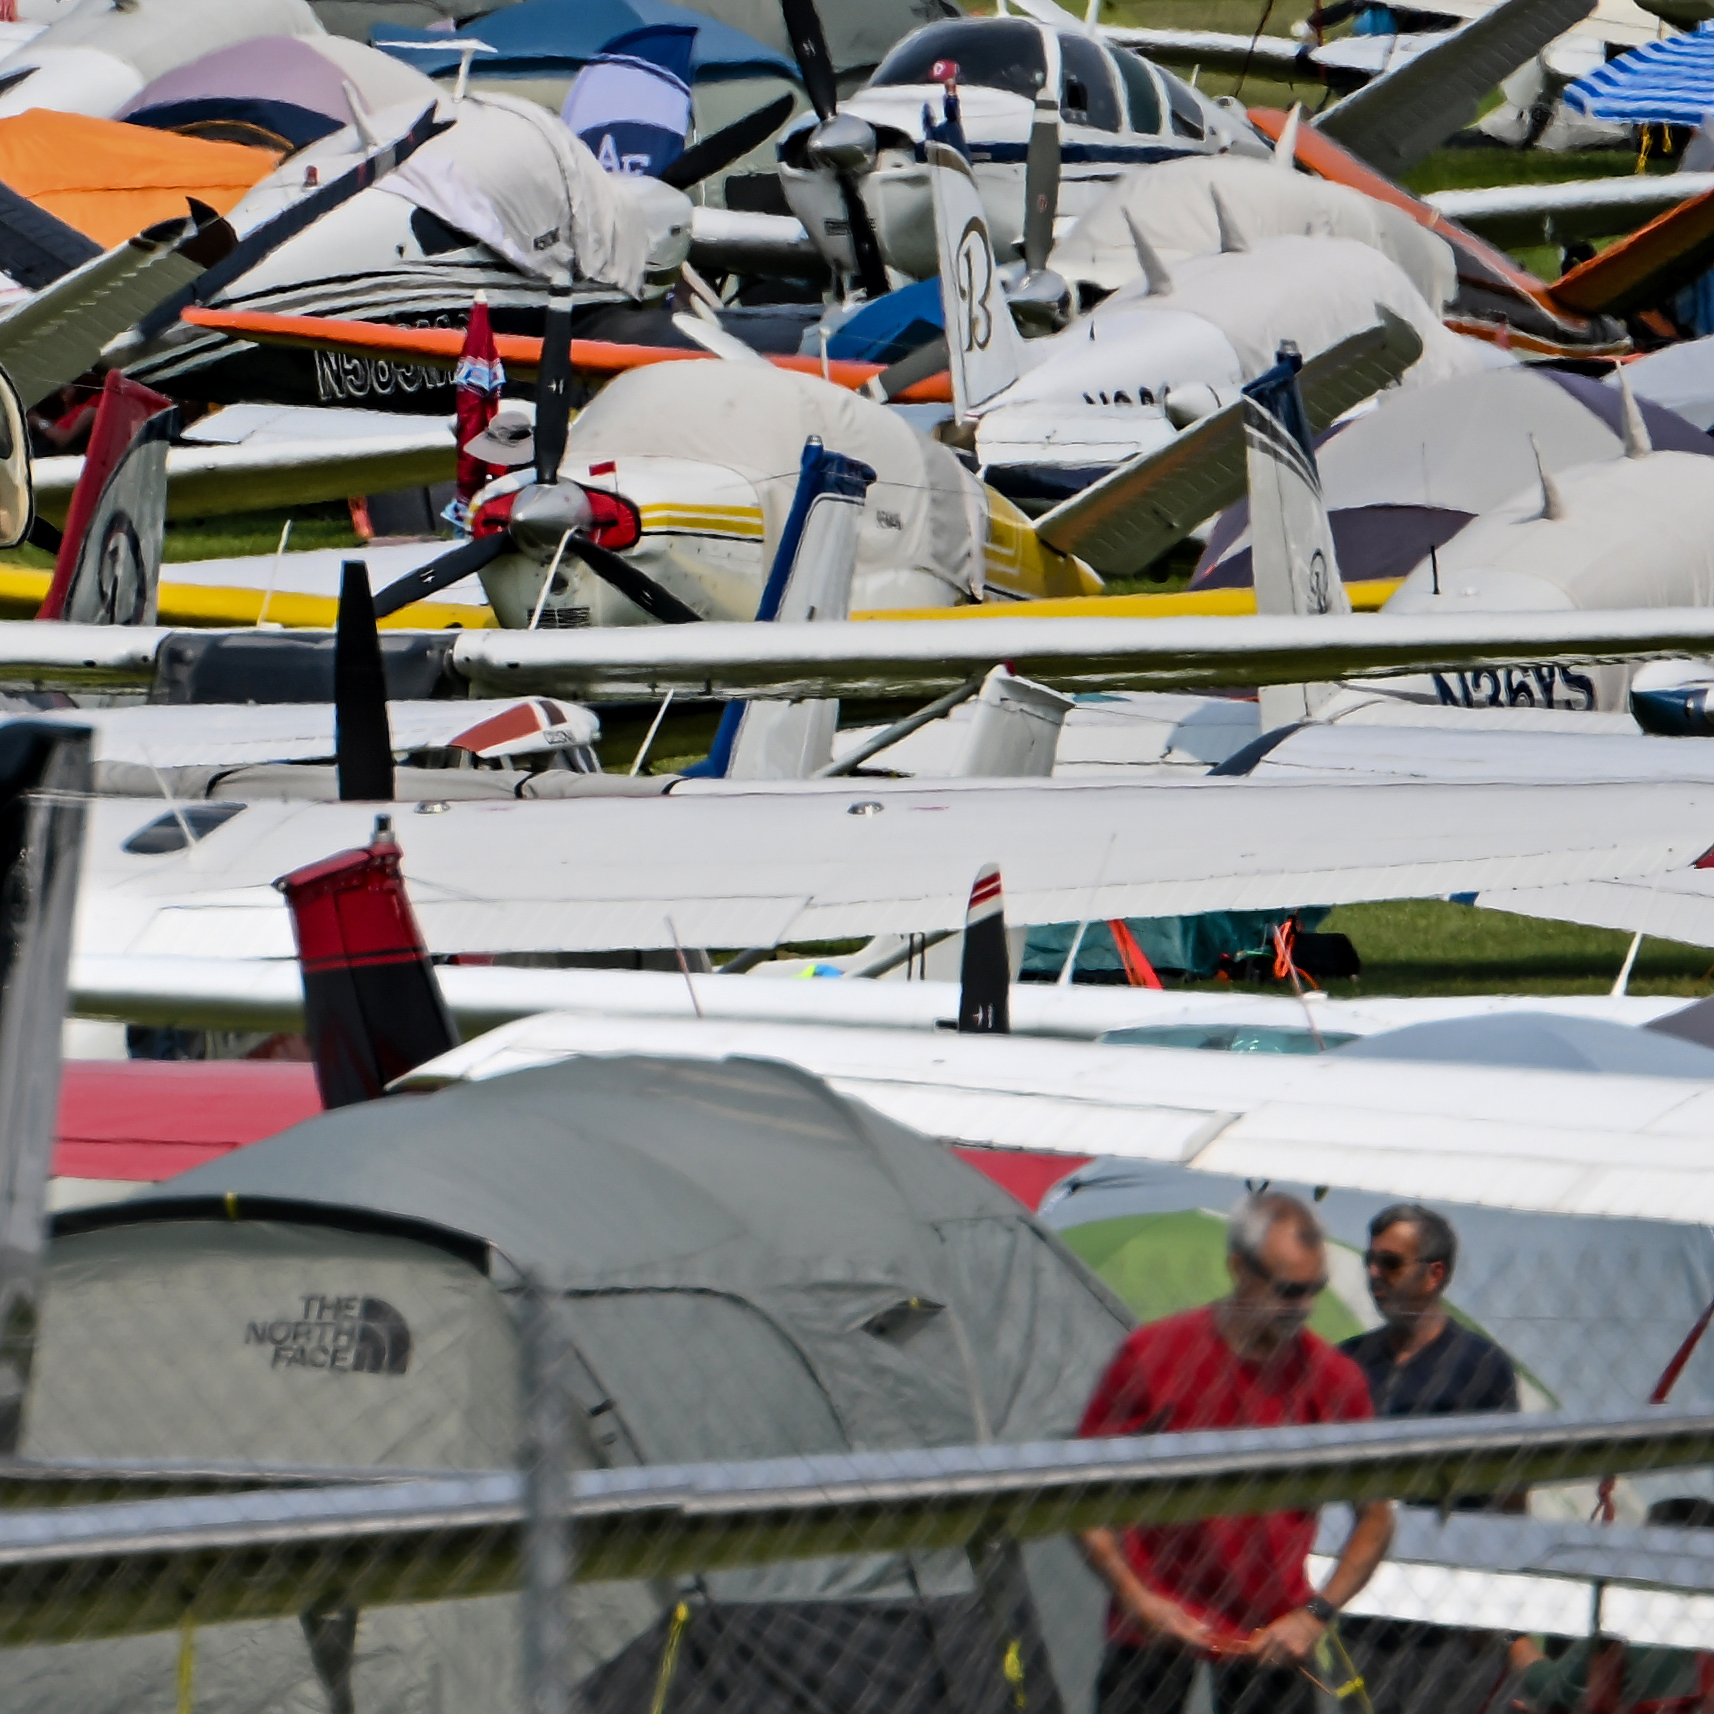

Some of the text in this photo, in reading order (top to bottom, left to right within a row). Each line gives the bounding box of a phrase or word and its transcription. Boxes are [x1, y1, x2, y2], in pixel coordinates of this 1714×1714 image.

[300, 1295, 358, 1319] THE
[244, 1320, 357, 1347] NORTH
[271, 1344, 349, 1373] FACE
